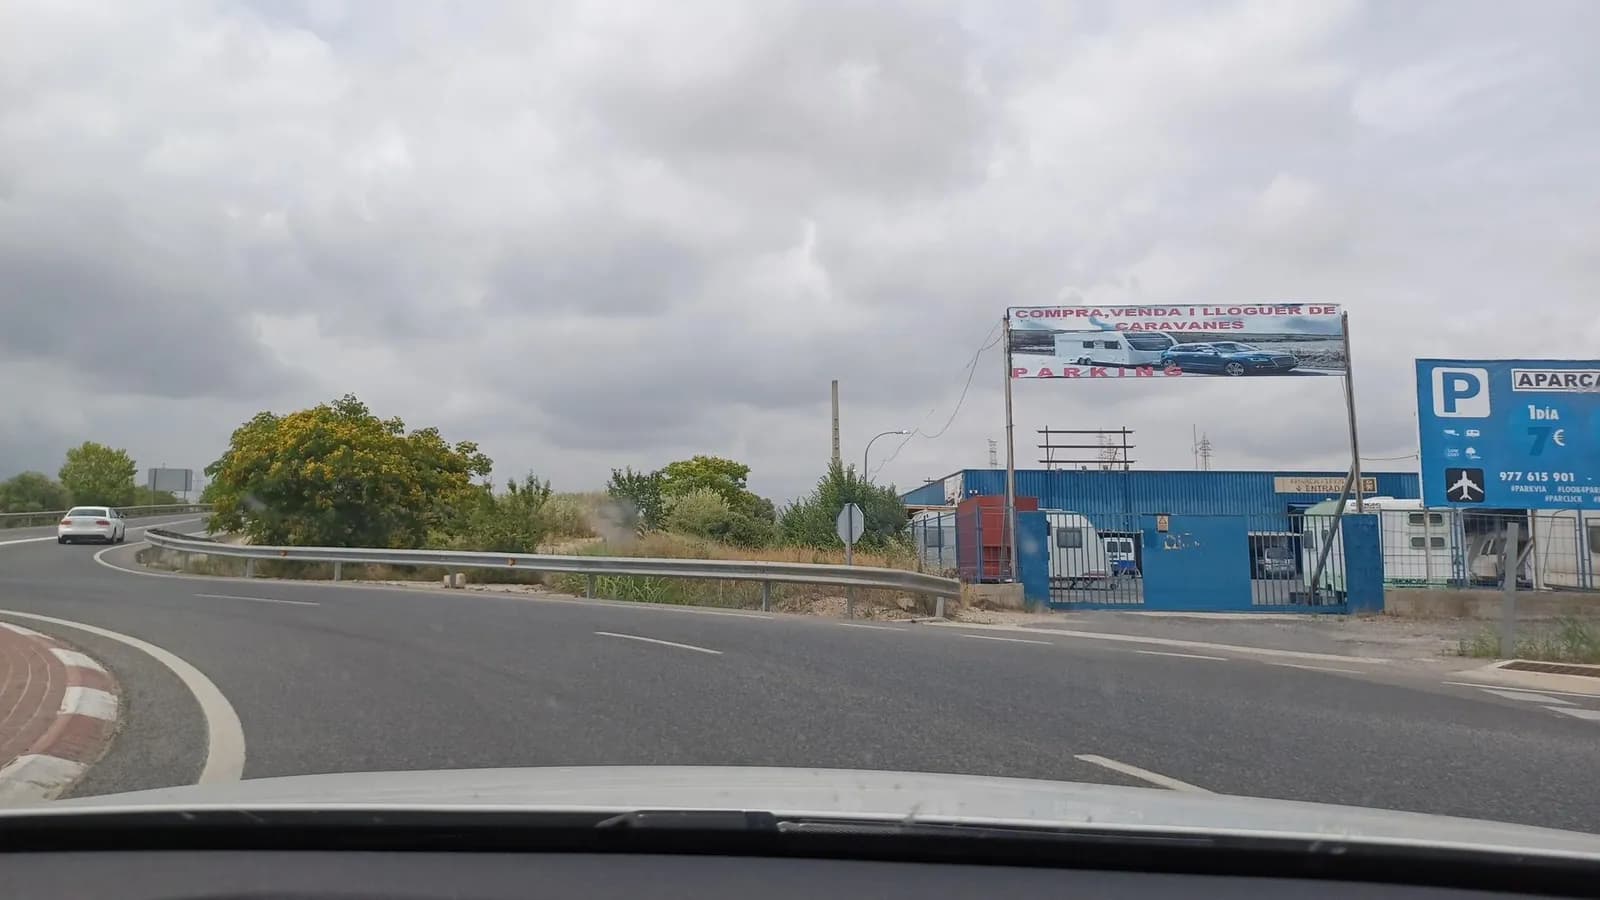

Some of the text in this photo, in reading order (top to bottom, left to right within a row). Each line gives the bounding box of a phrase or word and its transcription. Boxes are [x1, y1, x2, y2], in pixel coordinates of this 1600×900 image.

[1189, 308, 1195, 316] I
[1202, 307, 1301, 316] LLOGUER
[1309, 306, 1336, 315] DE
[1115, 321, 1245, 331] CARAVANES
[1012, 366, 1183, 378] PARKING
[1442, 372, 1481, 413] P
[1500, 472, 1521, 481] 977
[1527, 472, 1548, 482] 615
[1553, 472, 1575, 482] 901
[1511, 485, 1547, 493] #PARKVIA
